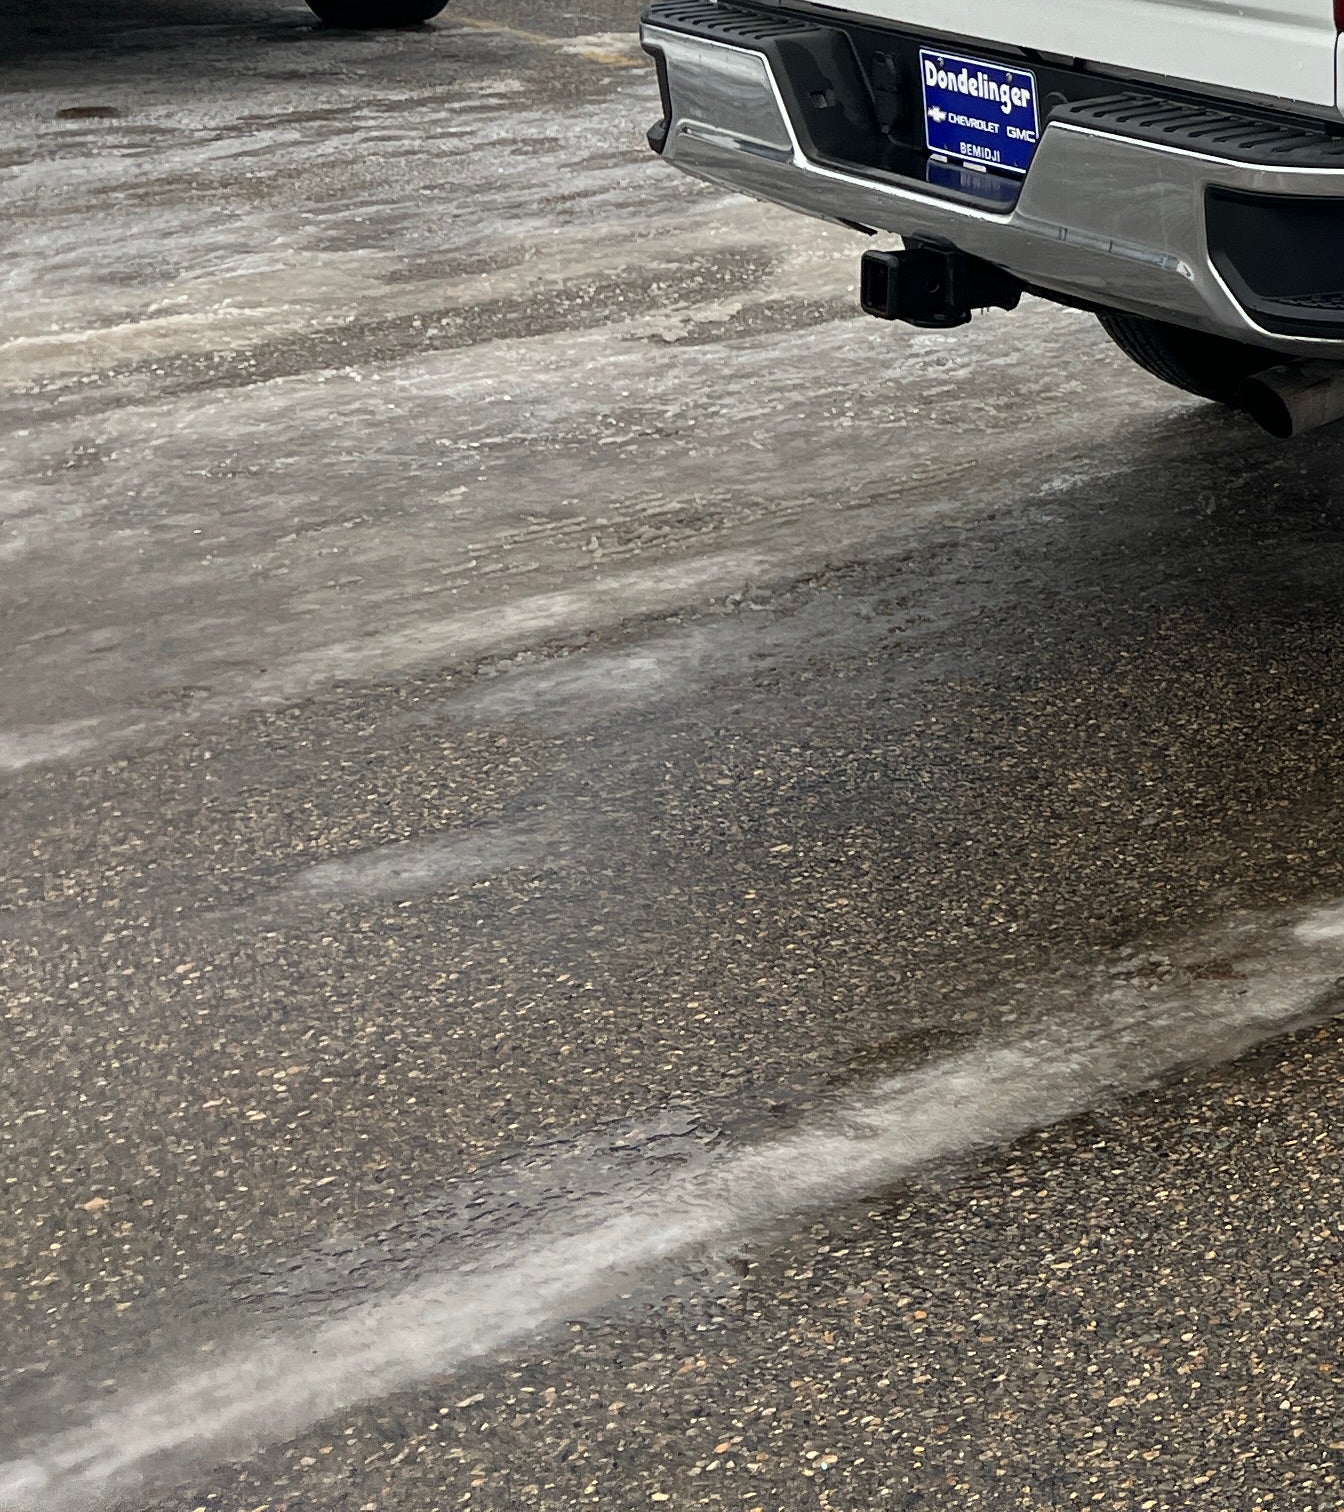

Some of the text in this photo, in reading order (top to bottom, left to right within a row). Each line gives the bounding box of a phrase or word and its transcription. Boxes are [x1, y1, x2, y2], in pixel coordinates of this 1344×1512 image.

[924, 59, 1031, 114] Dondelinger
[948, 112, 1036, 143] CHEVROLET GMC
[959, 141, 1001, 162] BEMIDJI
